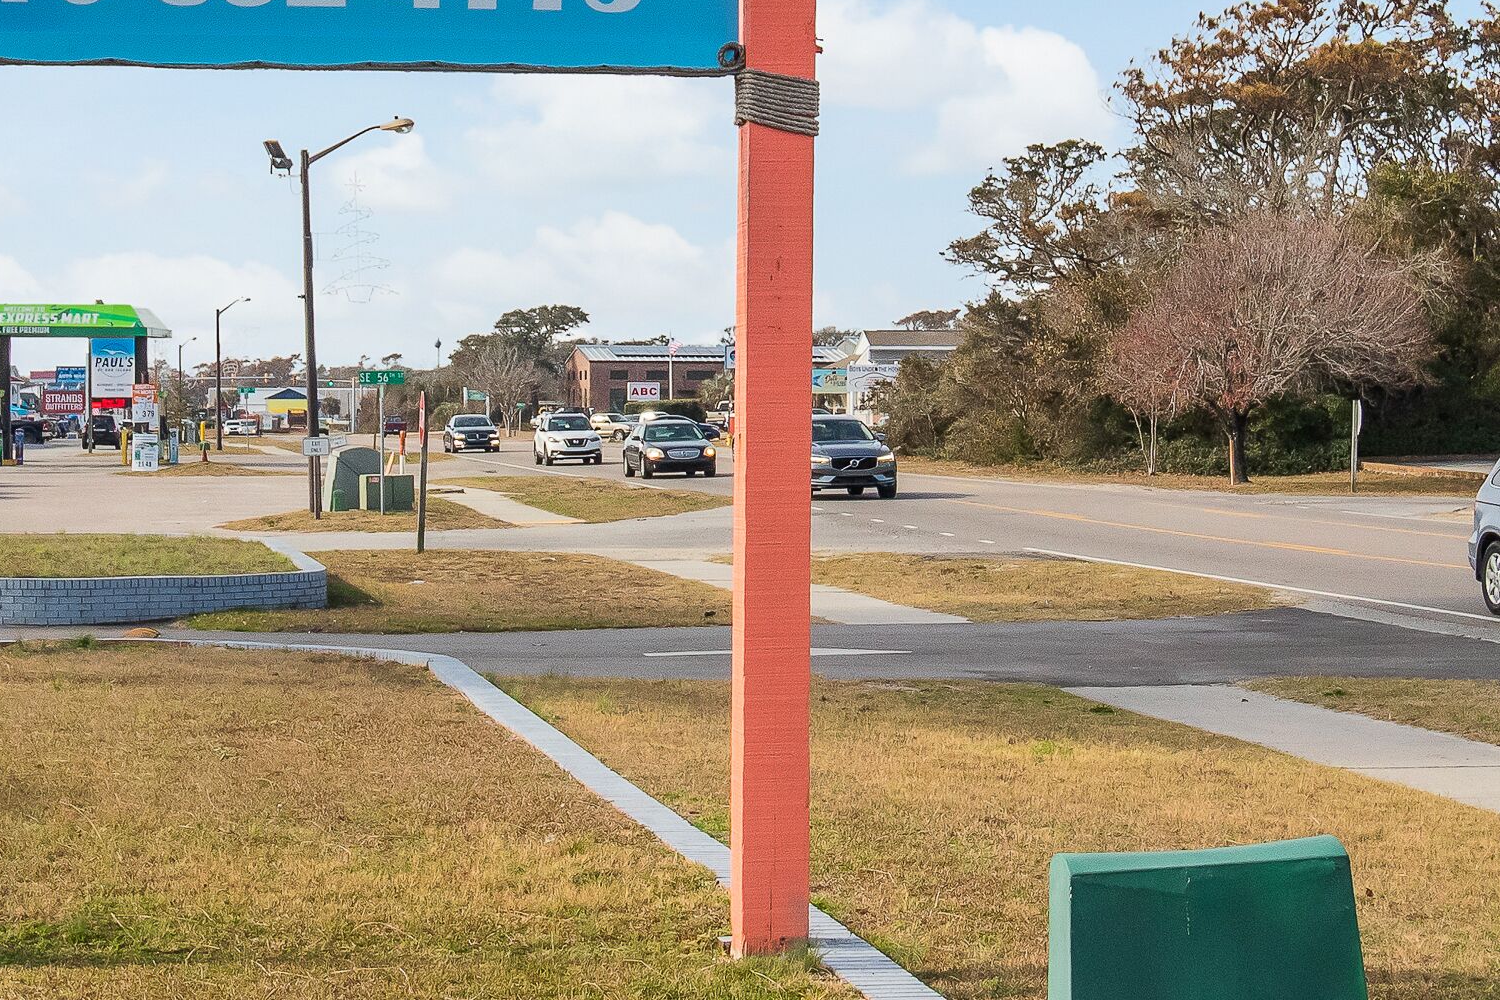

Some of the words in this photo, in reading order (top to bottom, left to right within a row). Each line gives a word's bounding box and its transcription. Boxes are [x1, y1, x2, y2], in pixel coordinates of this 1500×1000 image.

[59, 312, 100, 325] MART
[2, 326, 18, 334] FREE
[95, 357, 134, 368] PAUL'S
[360, 372, 371, 383] SE
[631, 387, 658, 396] ABC
[45, 393, 83, 403] STRANDS
[45, 403, 83, 411] OUTFITTERS
